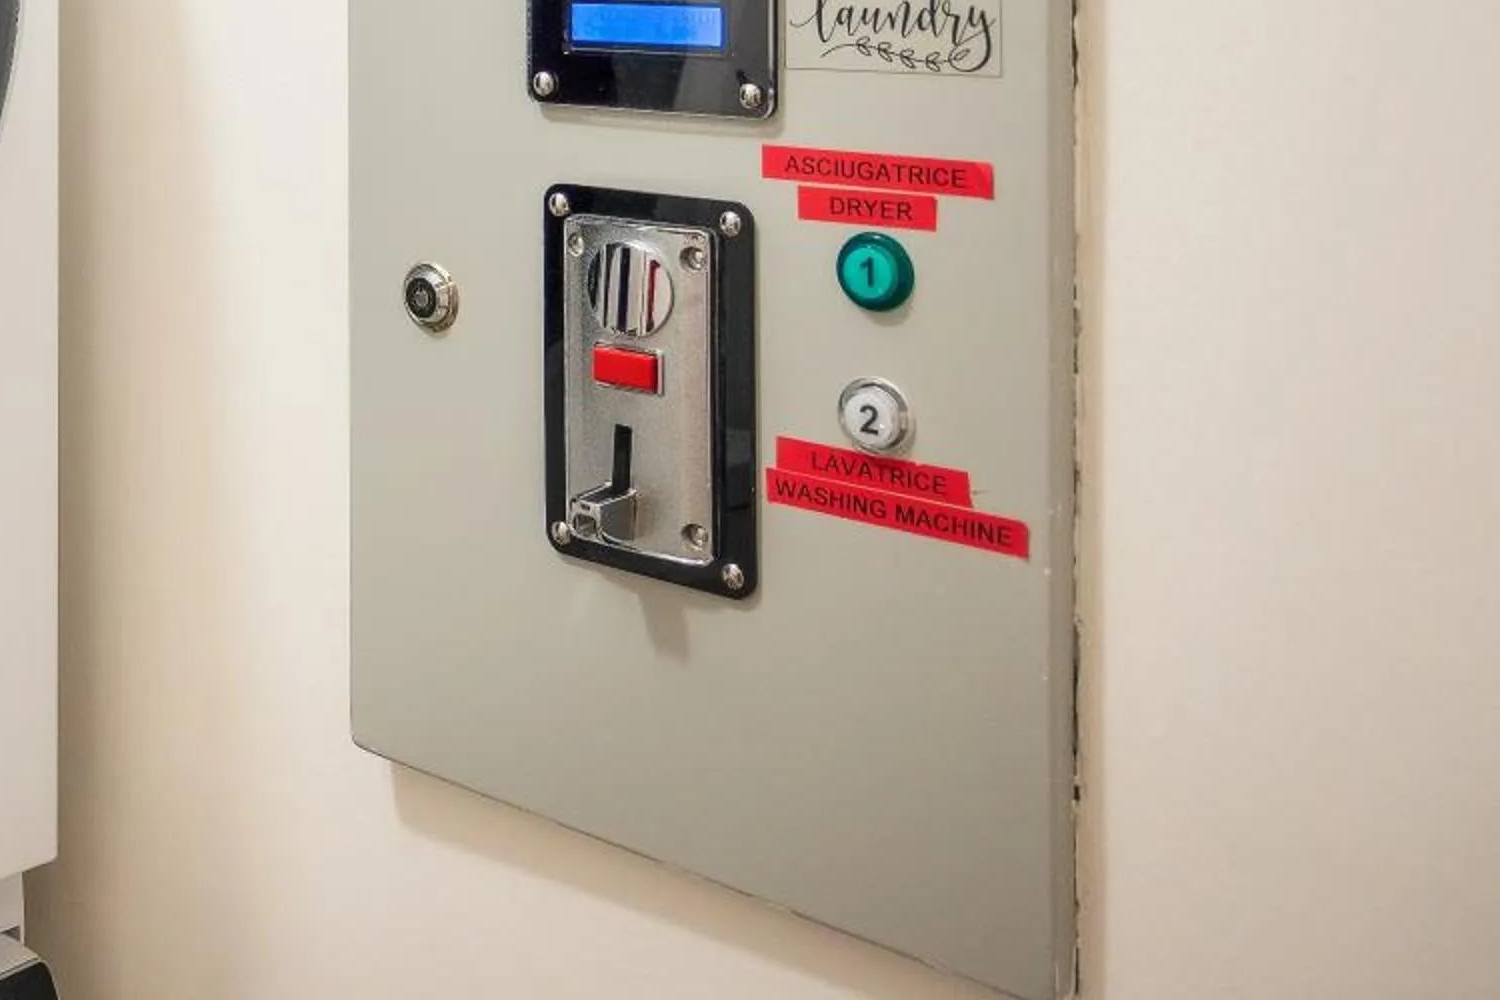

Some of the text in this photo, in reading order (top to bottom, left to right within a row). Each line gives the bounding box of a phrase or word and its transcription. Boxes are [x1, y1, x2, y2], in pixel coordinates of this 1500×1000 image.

[784, 155, 968, 189] ASCIUGATRICE
[829, 196, 914, 222] DRYER
[860, 256, 874, 288] 1
[860, 405, 879, 436] 2
[810, 451, 947, 496] LAVATRICE
[775, 478, 1013, 548] WASHING MACHINE
